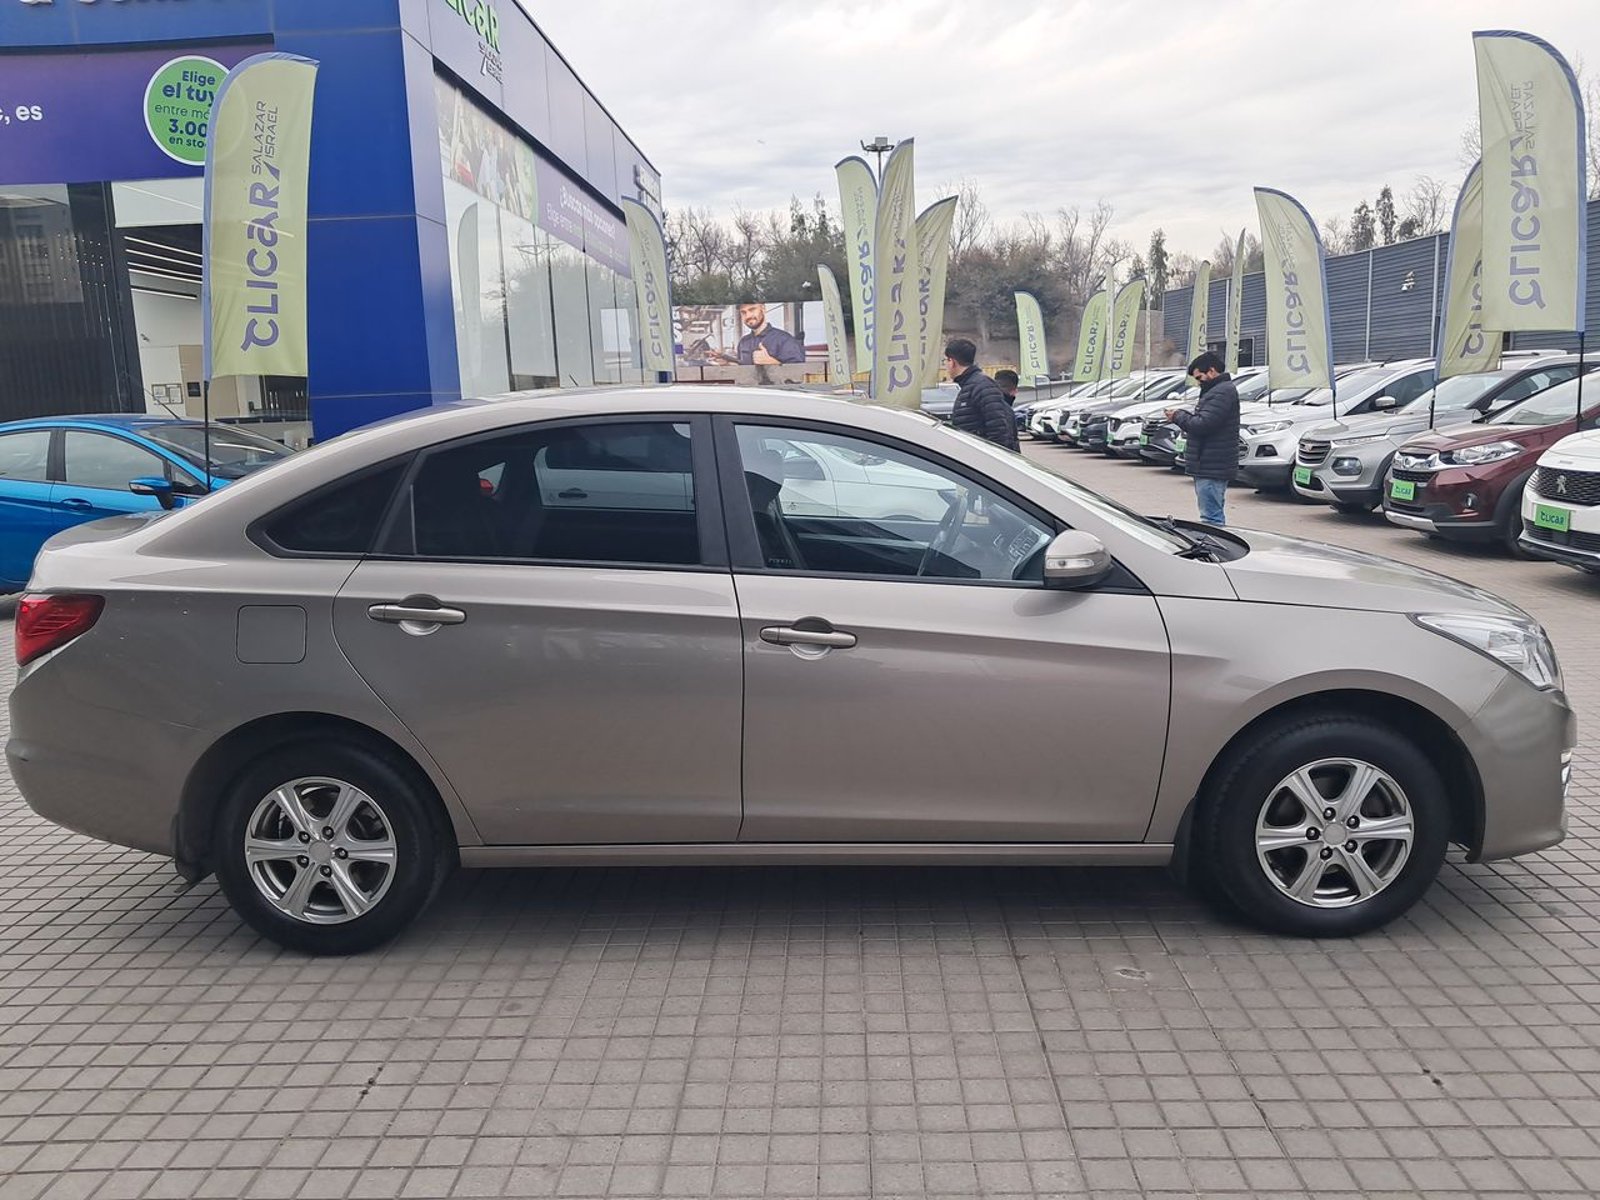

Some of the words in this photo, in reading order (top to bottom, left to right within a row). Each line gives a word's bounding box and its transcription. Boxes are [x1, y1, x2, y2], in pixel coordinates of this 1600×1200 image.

[182, 70, 216, 87] Elige
[162, 82, 181, 99] el
[186, 85, 215, 107] tuy
[15, 105, 43, 121] es
[154, 104, 188, 117] entre
[168, 118, 207, 138] 3.00
[264, 106, 278, 159] ISRAEL
[168, 136, 183, 145] en
[186, 138, 206, 149] sto
[251, 100, 267, 175] SALAZAR
